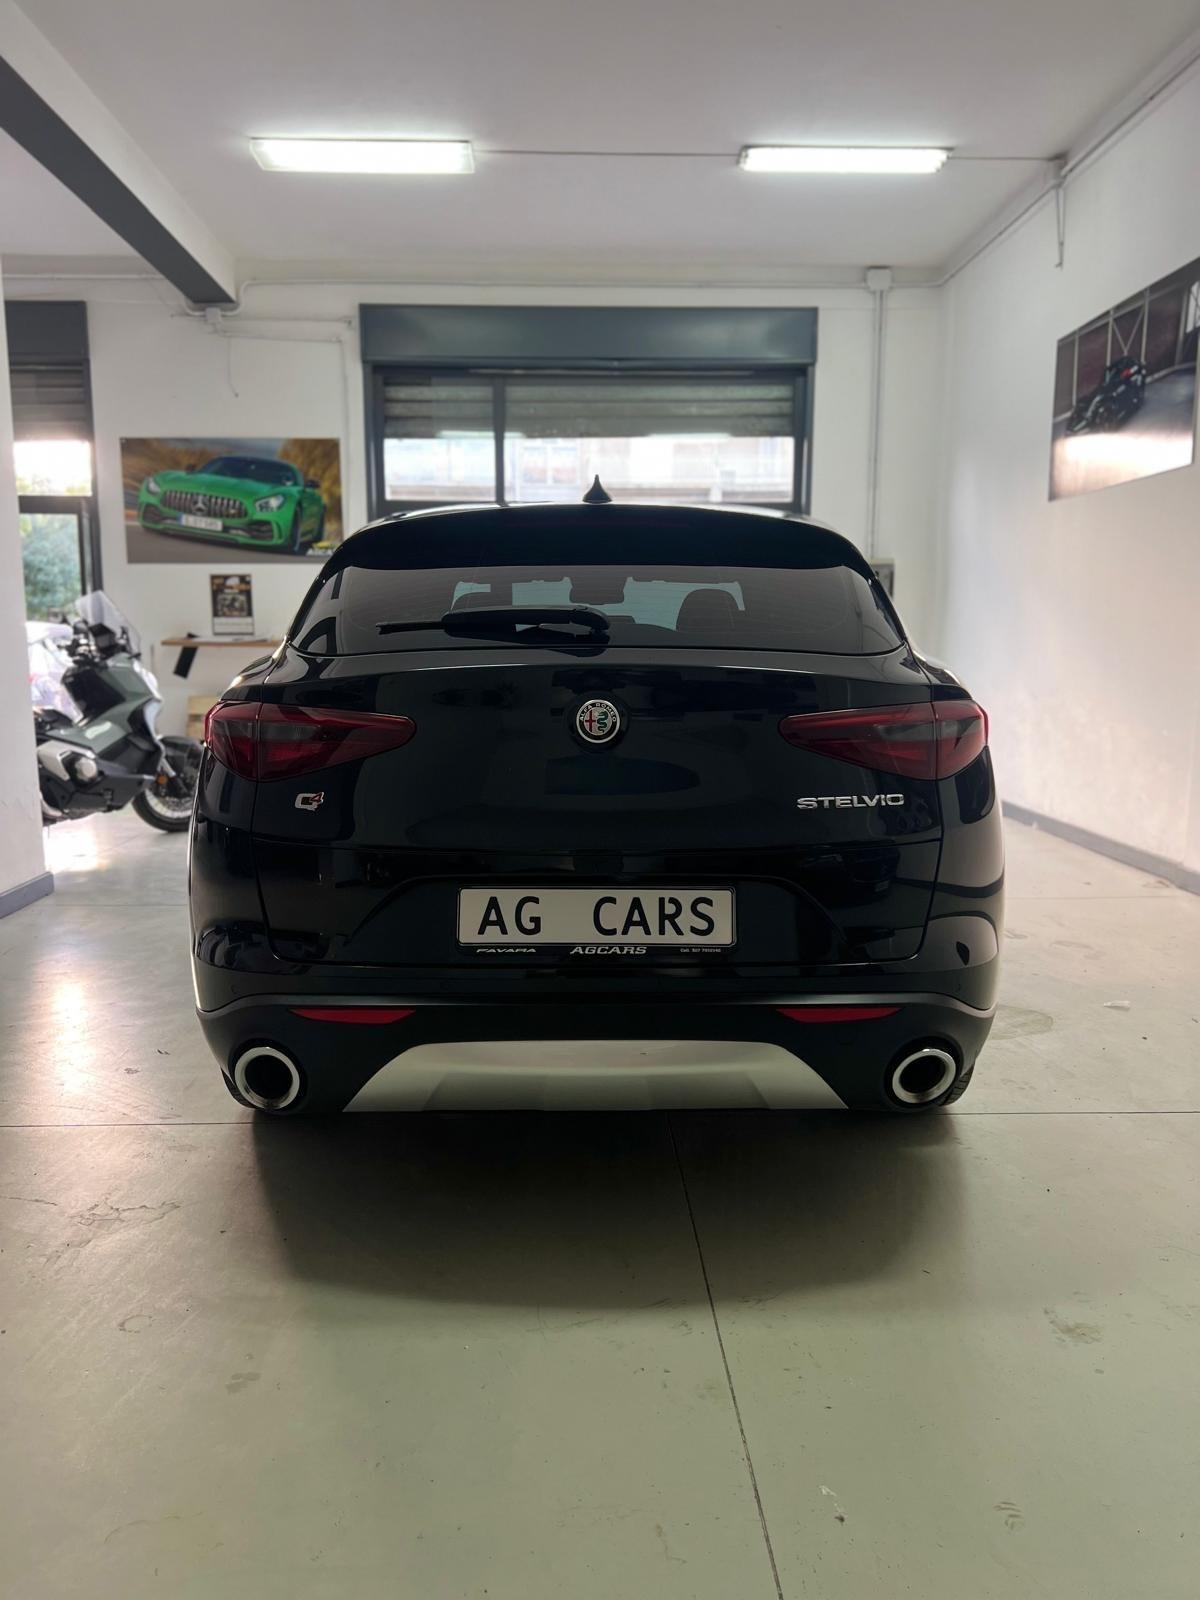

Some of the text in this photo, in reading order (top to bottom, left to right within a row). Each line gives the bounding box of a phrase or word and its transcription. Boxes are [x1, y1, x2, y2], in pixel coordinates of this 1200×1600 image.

[580, 703, 617, 721] ALFA ROMEO
[797, 793, 905, 809] STELVIO
[477, 895, 716, 937] AG CARS
[569, 946, 648, 955] AGCARS
